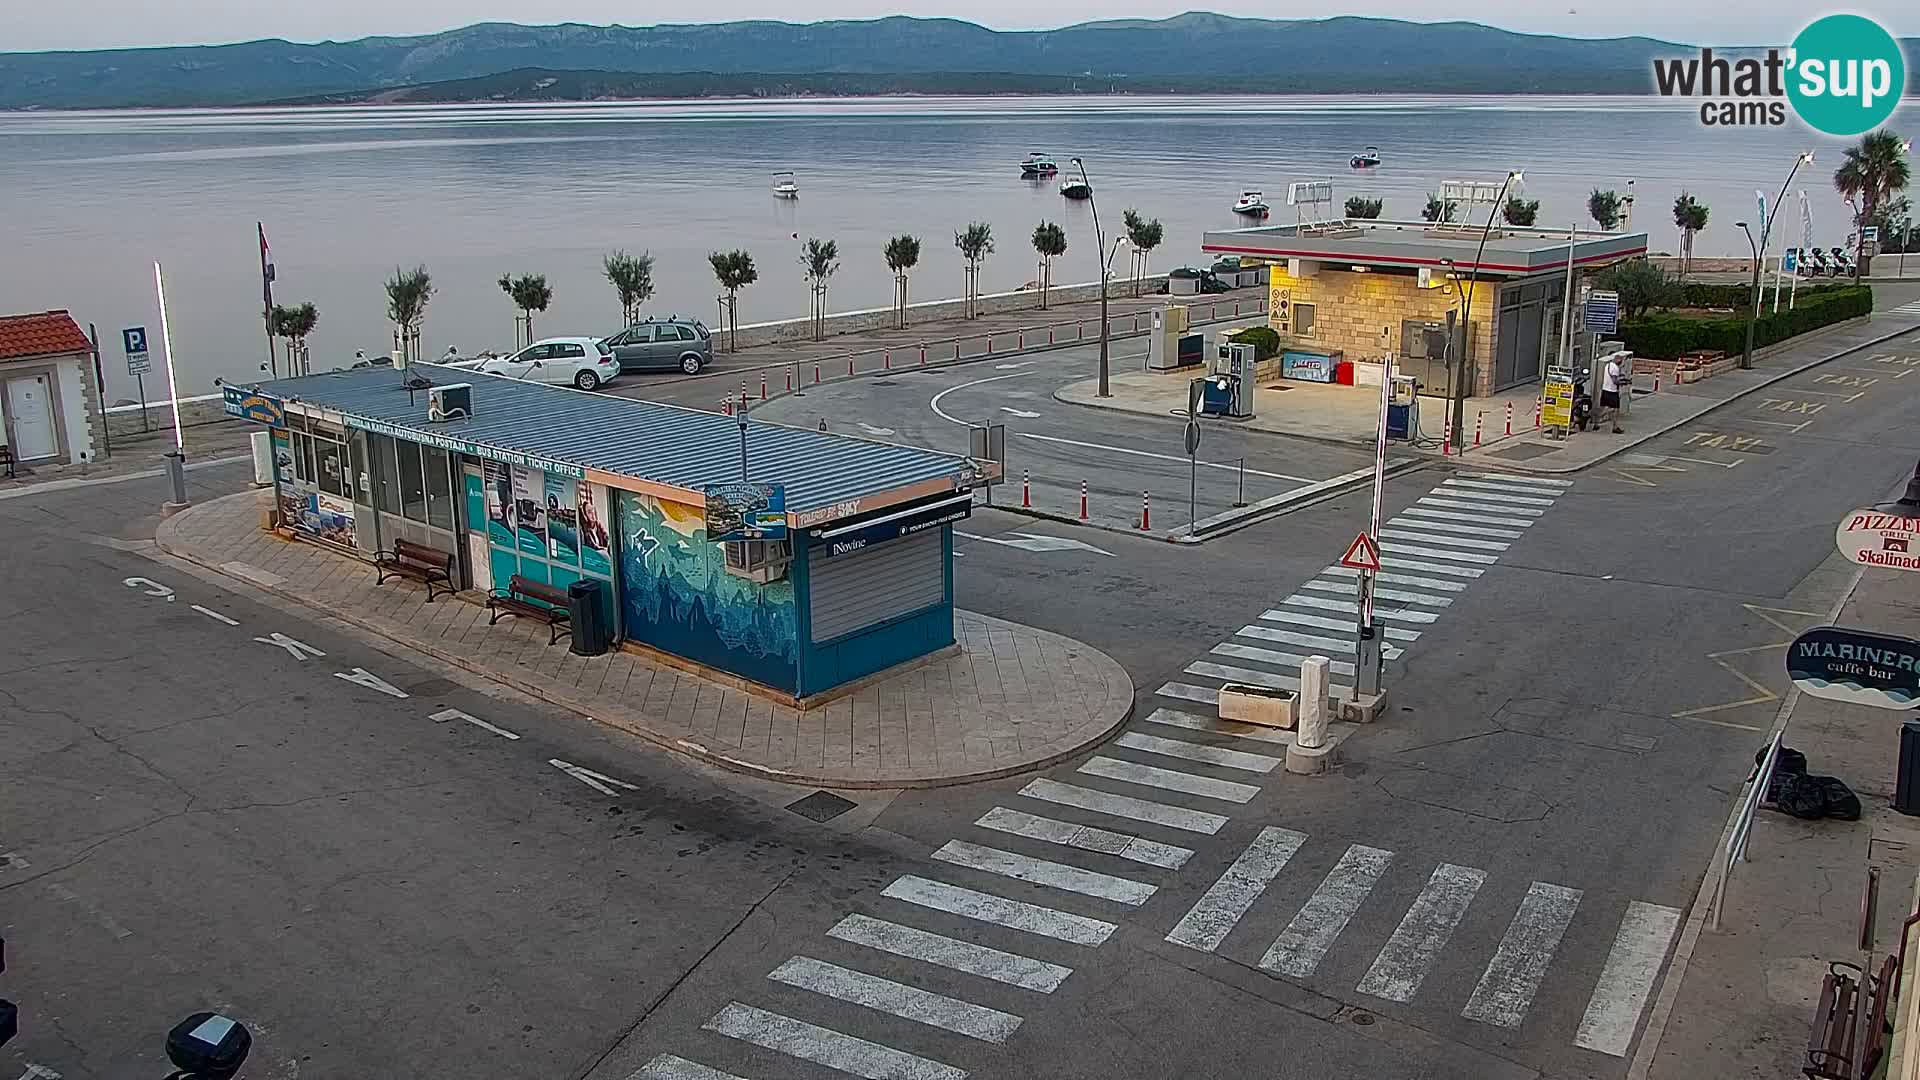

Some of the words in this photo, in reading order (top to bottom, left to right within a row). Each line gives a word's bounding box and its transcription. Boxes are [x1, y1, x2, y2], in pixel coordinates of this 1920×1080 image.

[128, 331, 141, 350] P
[1813, 374, 1879, 388] TAXI
[1757, 398, 1827, 414] TAXI
[1684, 432, 1762, 451] TAXI
[394, 428, 435, 445] AUTOBUSNA
[435, 437, 467, 452] POSTAJA
[476, 446, 492, 458] BUS
[493, 450, 525, 465] STATION
[527, 456, 553, 471] TICKET
[554, 463, 581, 477] OFFICE
[1880, 530, 1915, 541] GRILL
[1827, 662, 1865, 675] caffe
[1869, 665, 1896, 680] bar
